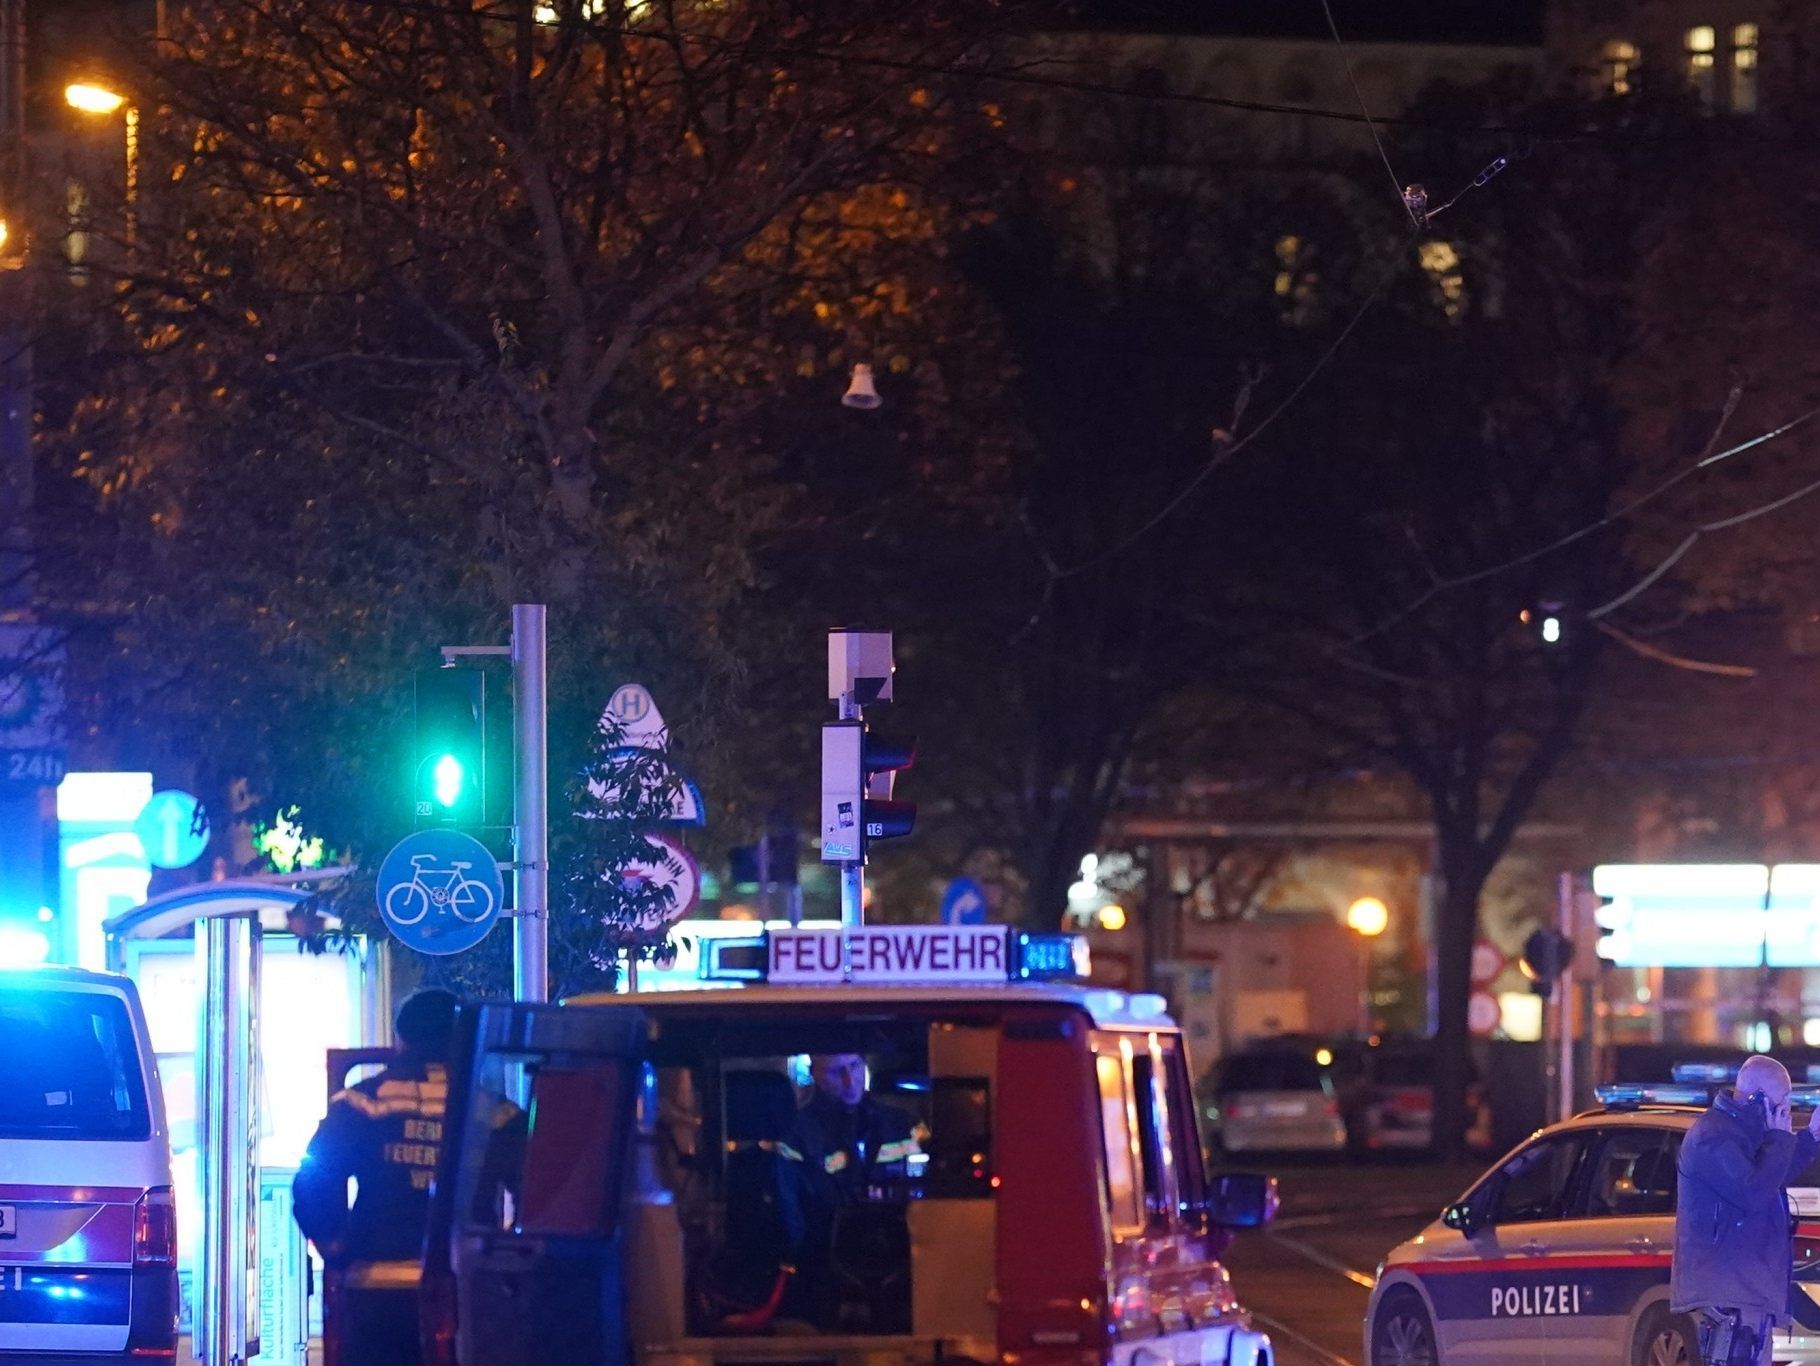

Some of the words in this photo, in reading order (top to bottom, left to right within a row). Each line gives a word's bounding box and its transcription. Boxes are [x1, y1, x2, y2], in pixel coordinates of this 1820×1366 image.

[869, 824, 882, 835] 16
[773, 934, 1001, 972] FEUERWEHR
[1491, 1284, 1580, 1317] POLIZEI
